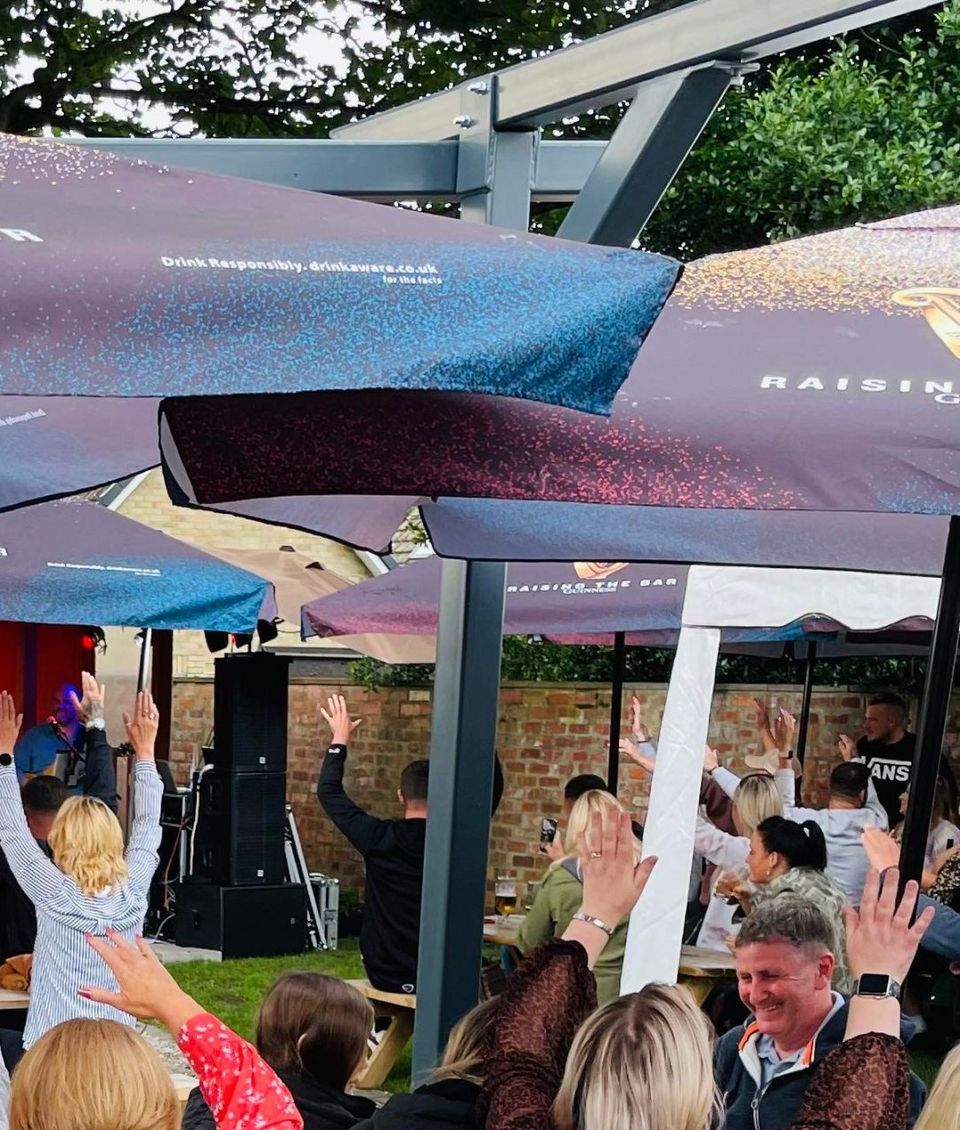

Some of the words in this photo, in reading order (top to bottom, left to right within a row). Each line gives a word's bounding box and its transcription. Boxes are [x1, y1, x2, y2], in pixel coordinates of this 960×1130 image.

[160, 256, 208, 268] Drink
[382, 275, 397, 284] for
[399, 276, 416, 284] the
[760, 376, 953, 394] RAISIN
[507, 582, 586, 593] RAISING
[595, 580, 632, 589] THE
[640, 578, 677, 588] BAR
